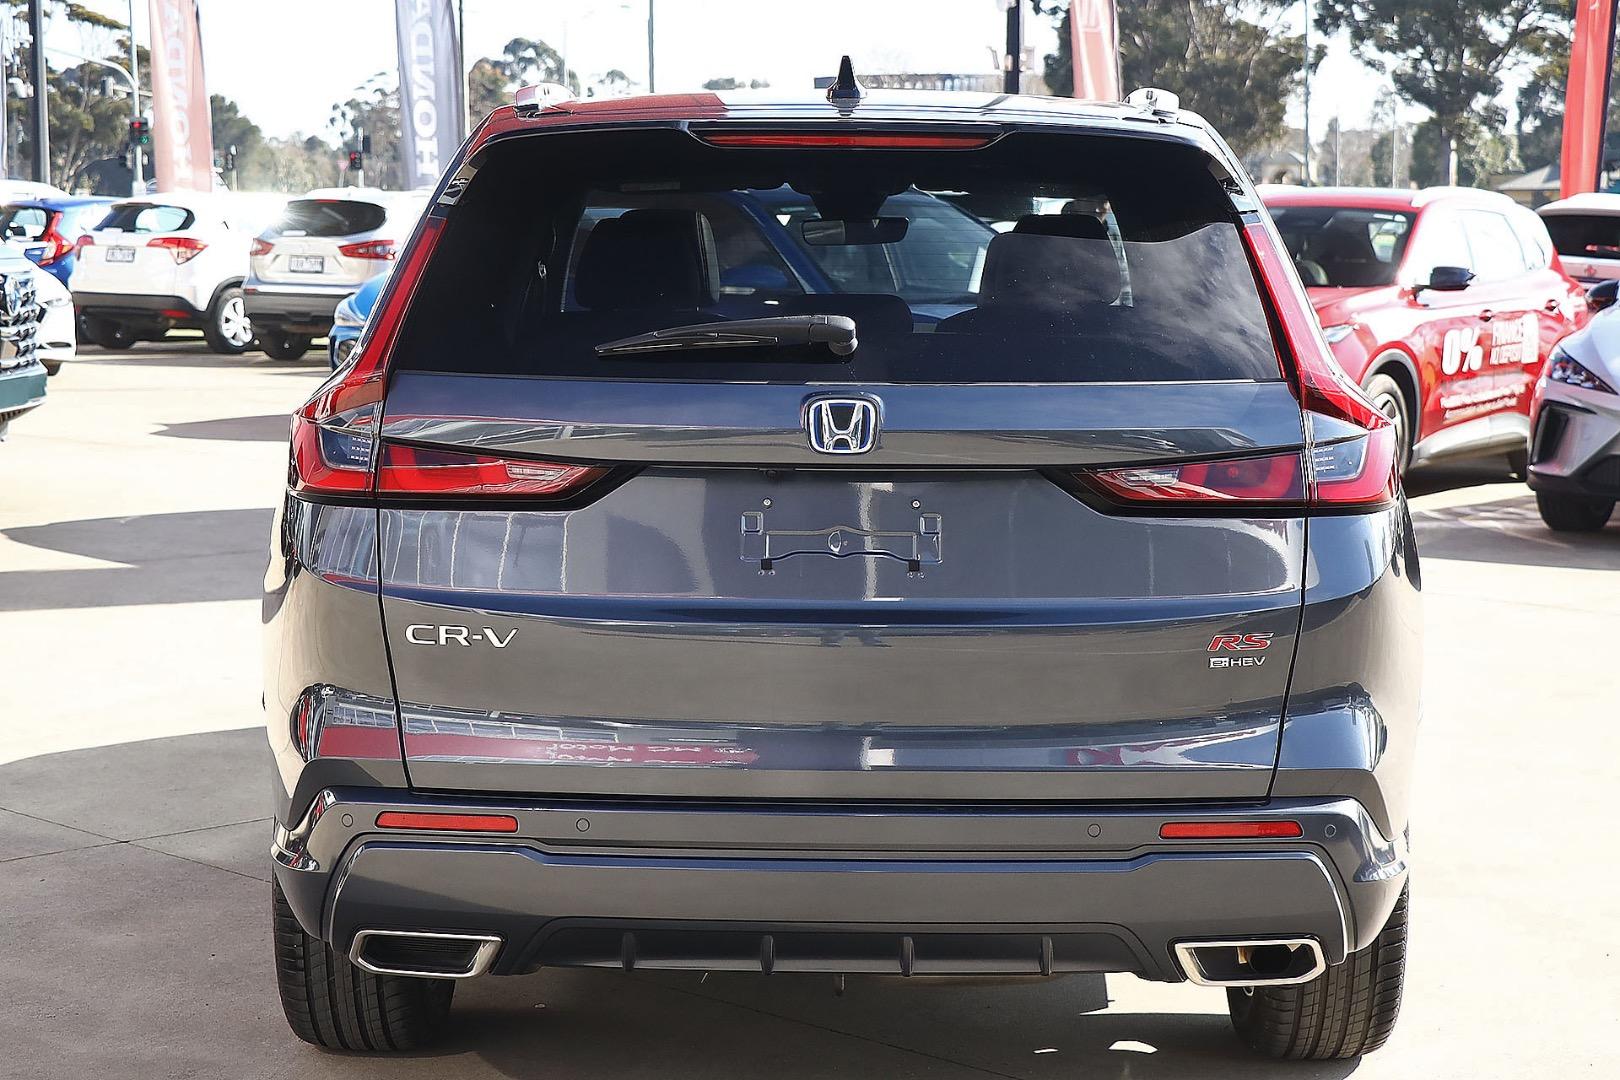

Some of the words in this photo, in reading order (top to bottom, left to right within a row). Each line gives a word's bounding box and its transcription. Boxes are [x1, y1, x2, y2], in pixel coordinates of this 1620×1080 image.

[1441, 326, 1484, 376] 0%
[405, 624, 519, 648] CR-V
[1207, 632, 1275, 652] RS
